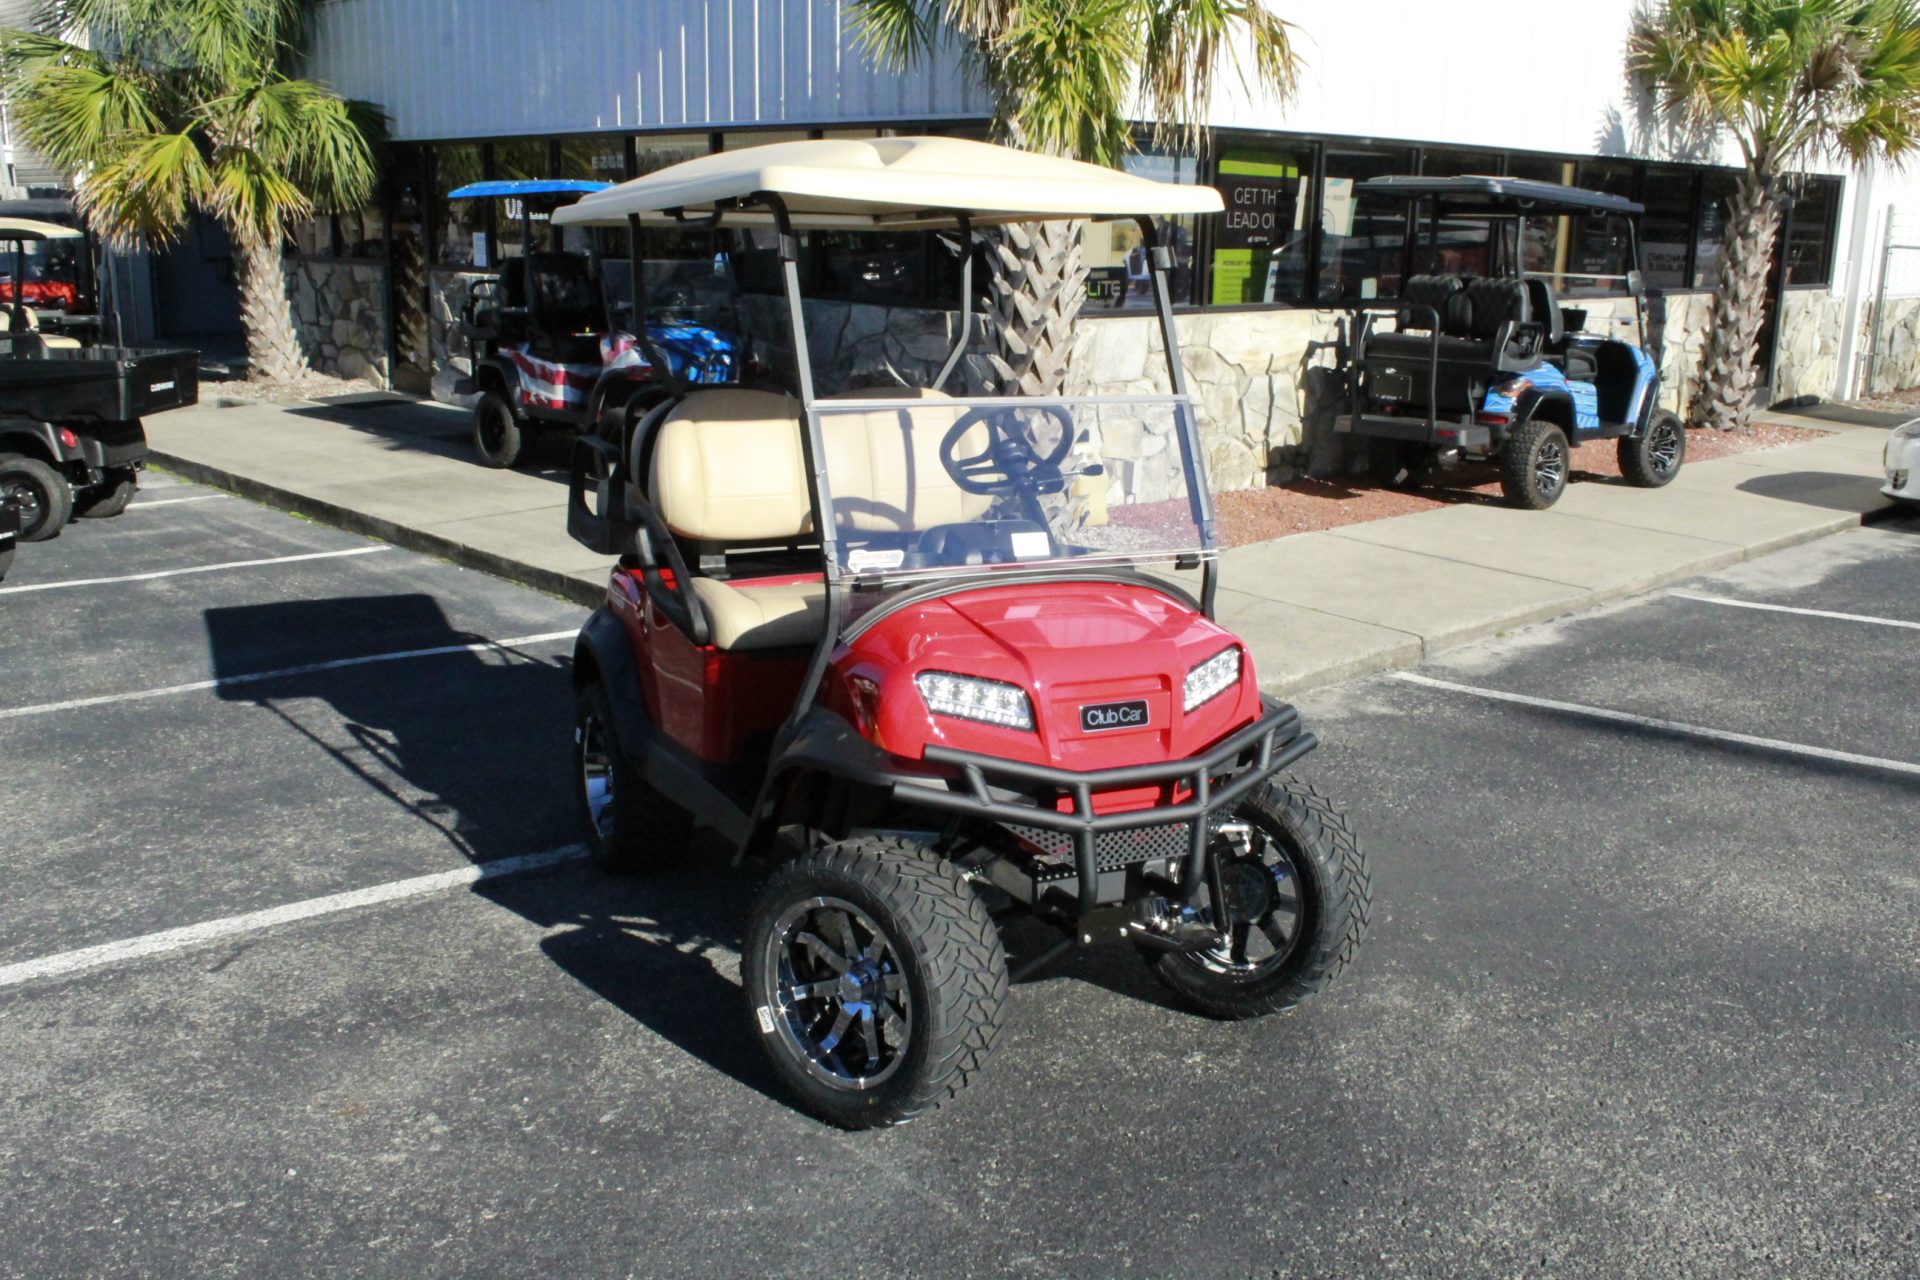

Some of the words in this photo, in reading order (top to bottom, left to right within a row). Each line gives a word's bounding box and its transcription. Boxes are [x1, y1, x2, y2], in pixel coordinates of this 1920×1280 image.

[1234, 186, 1259, 204] GET
[1260, 187, 1282, 205] TH
[1226, 211, 1260, 228] LEAD
[1087, 708, 1118, 726] Club
[1119, 706, 1142, 722] Car
